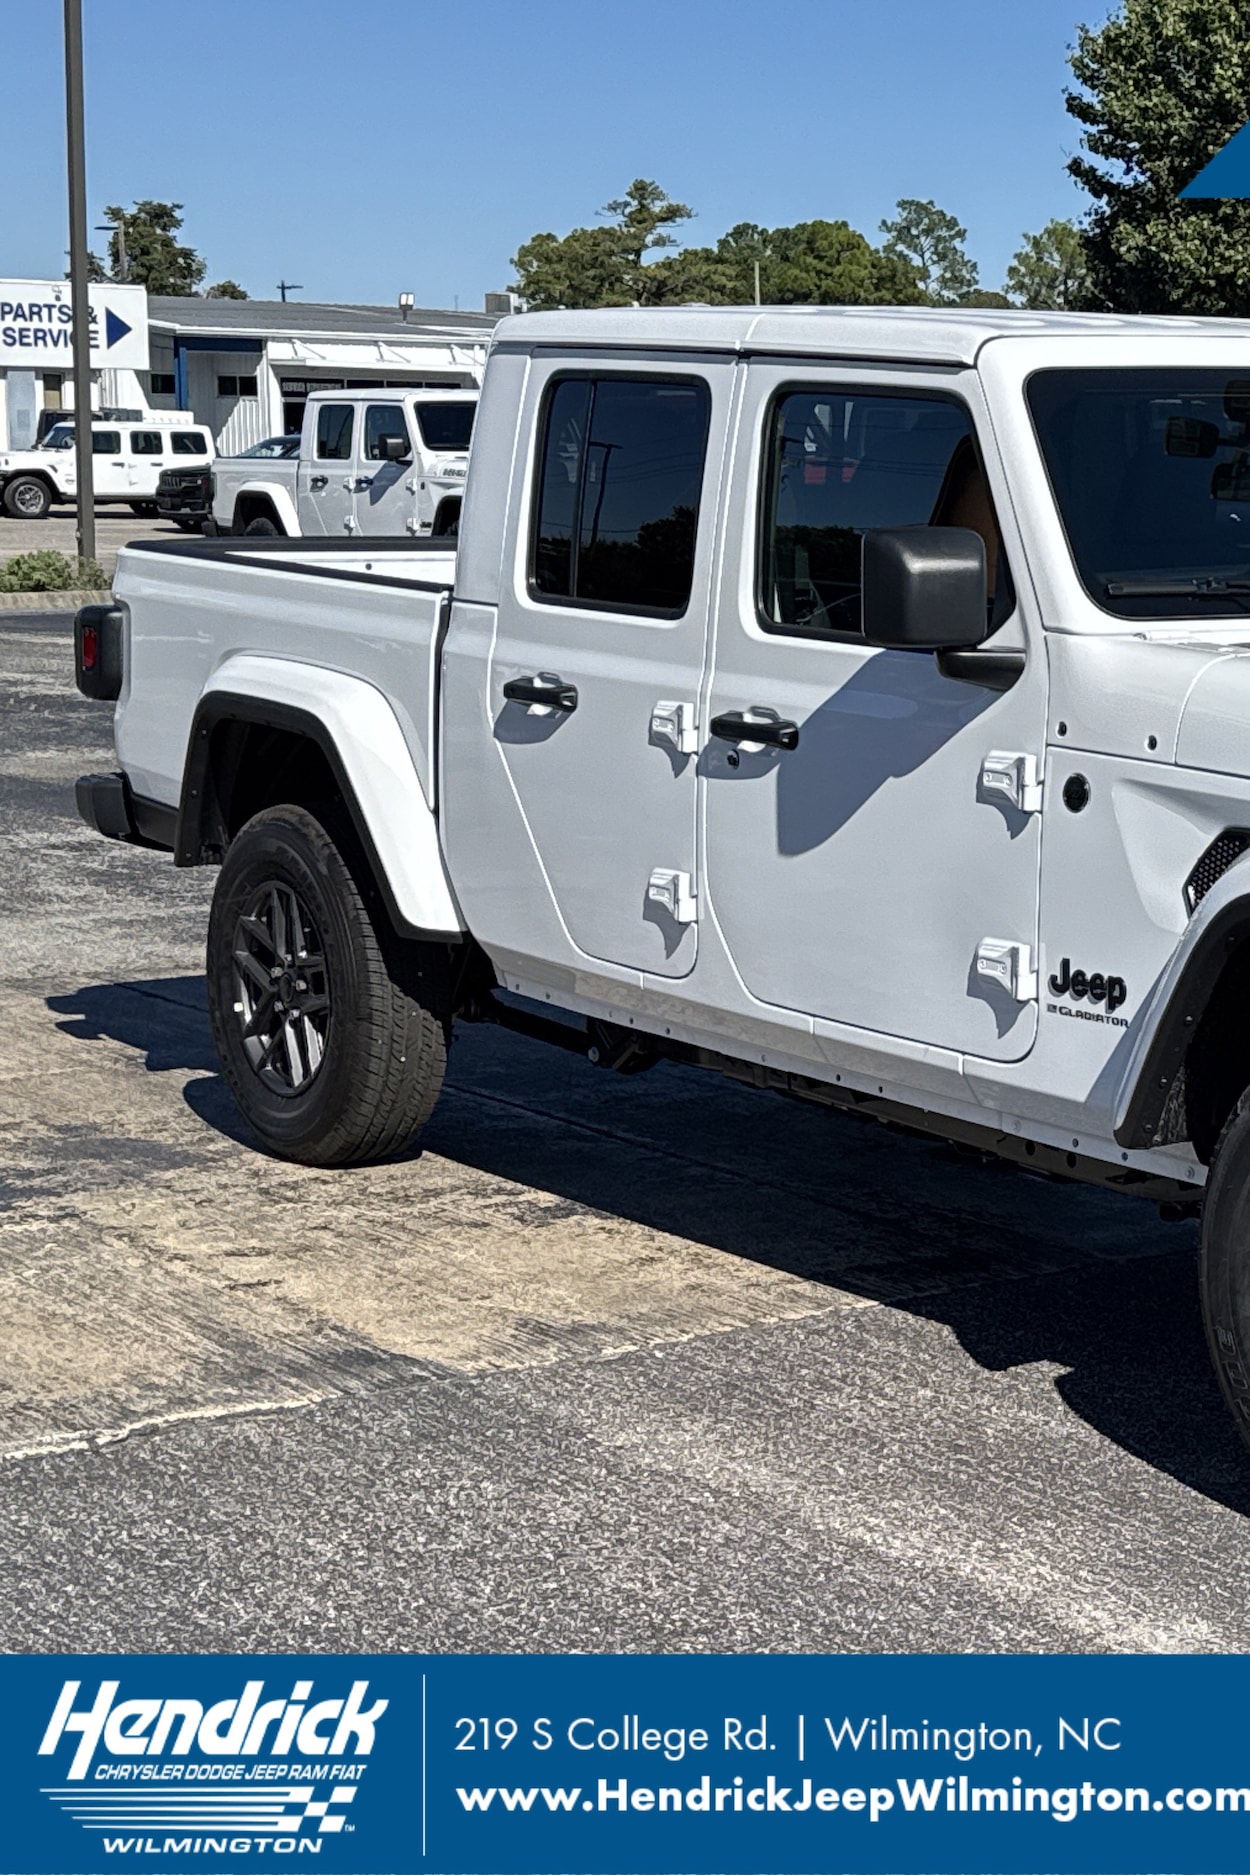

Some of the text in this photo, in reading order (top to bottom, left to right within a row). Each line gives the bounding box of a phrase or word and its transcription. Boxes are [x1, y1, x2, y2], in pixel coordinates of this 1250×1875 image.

[0, 302, 73, 323] PARTS
[2, 326, 100, 349] SERVIE
[1047, 957, 1128, 1014] Jeep
[1058, 1006, 1130, 1029] GLADIATOR
